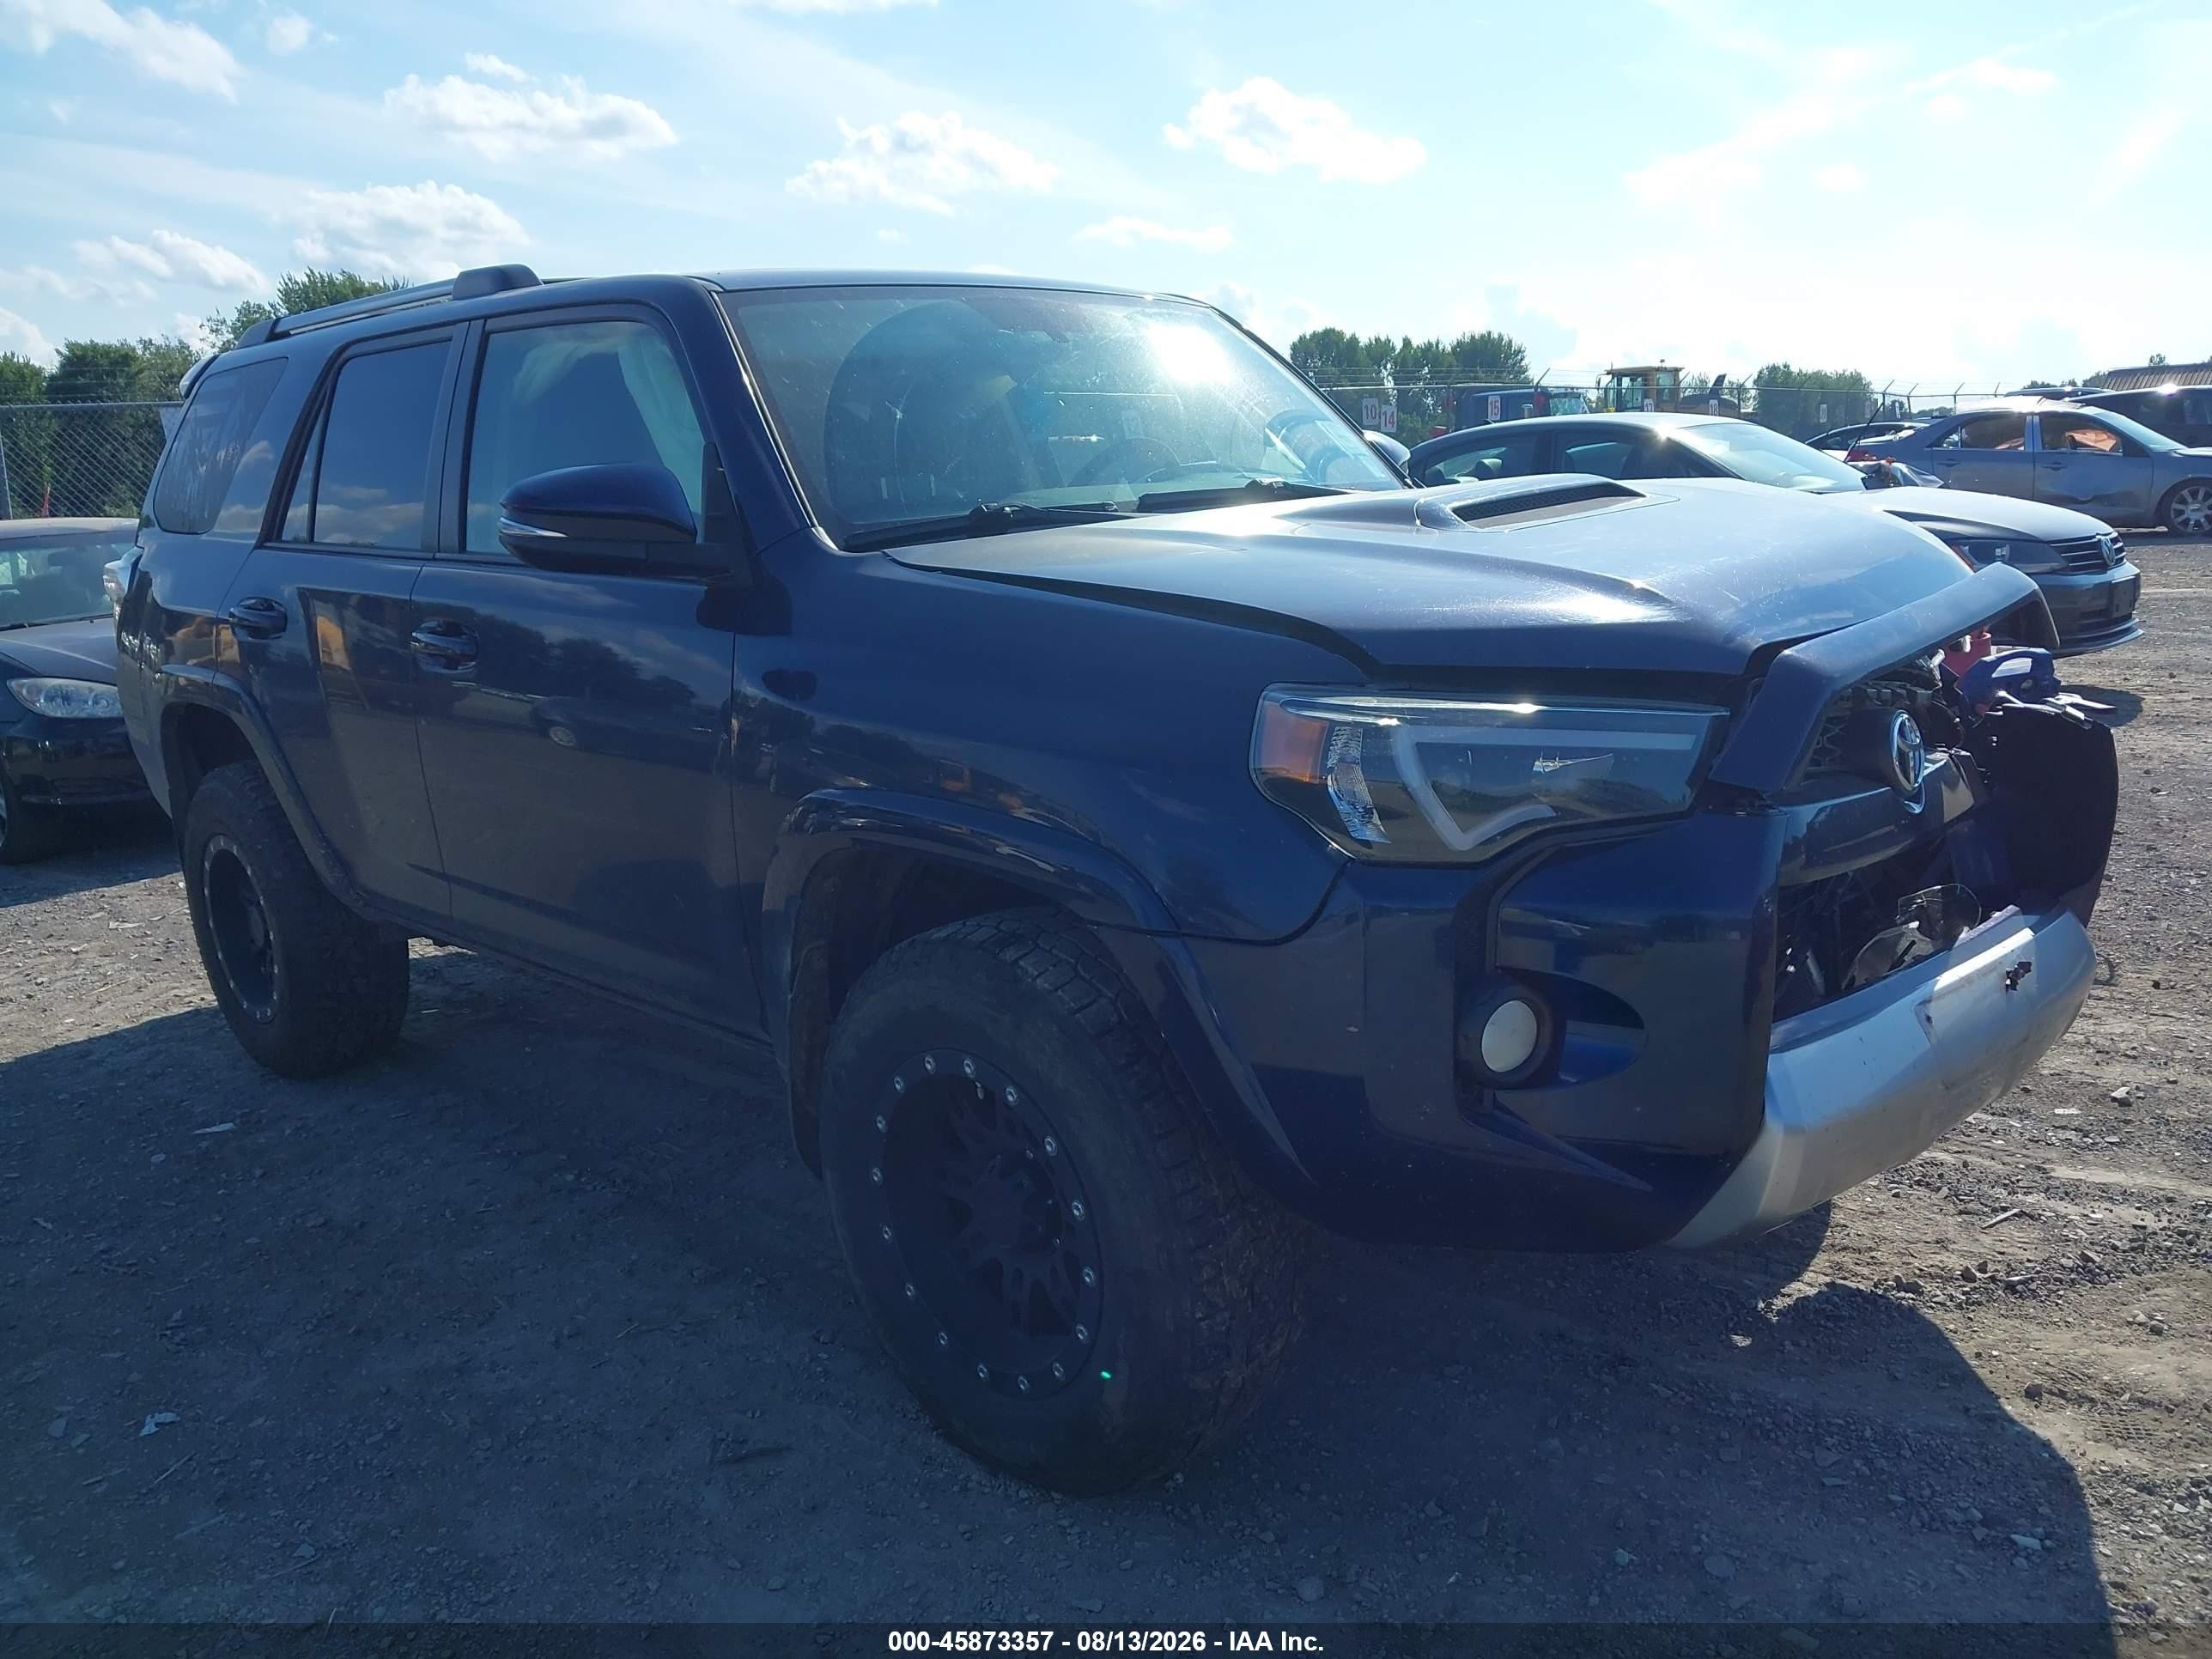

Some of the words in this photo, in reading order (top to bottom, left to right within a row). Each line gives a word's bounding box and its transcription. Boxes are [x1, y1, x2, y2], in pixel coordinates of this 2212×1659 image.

[1364, 404, 1377, 420] 10
[1489, 400, 1499, 416] 15
[1382, 411, 1395, 428] 14
